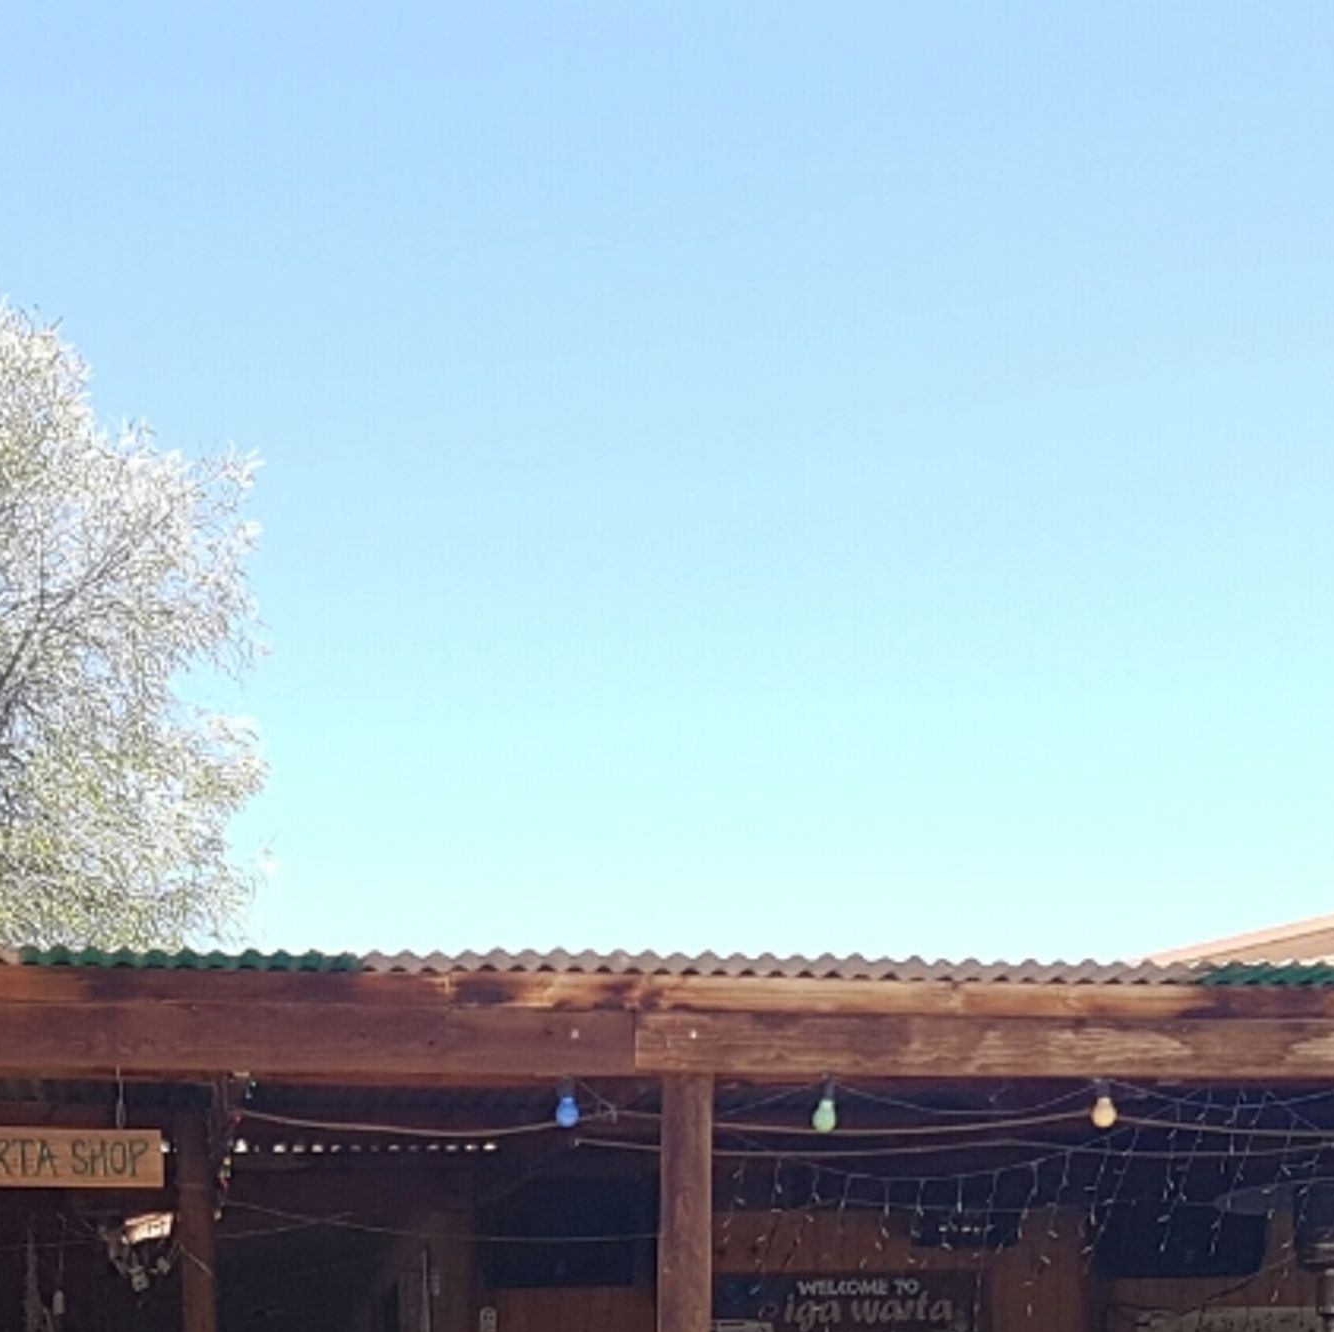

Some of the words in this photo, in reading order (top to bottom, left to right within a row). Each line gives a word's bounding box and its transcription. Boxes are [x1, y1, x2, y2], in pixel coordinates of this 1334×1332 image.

[71, 1138, 149, 1178] SHOP
[796, 1280, 889, 1296] WELCOME
[893, 1278, 920, 1296] TO
